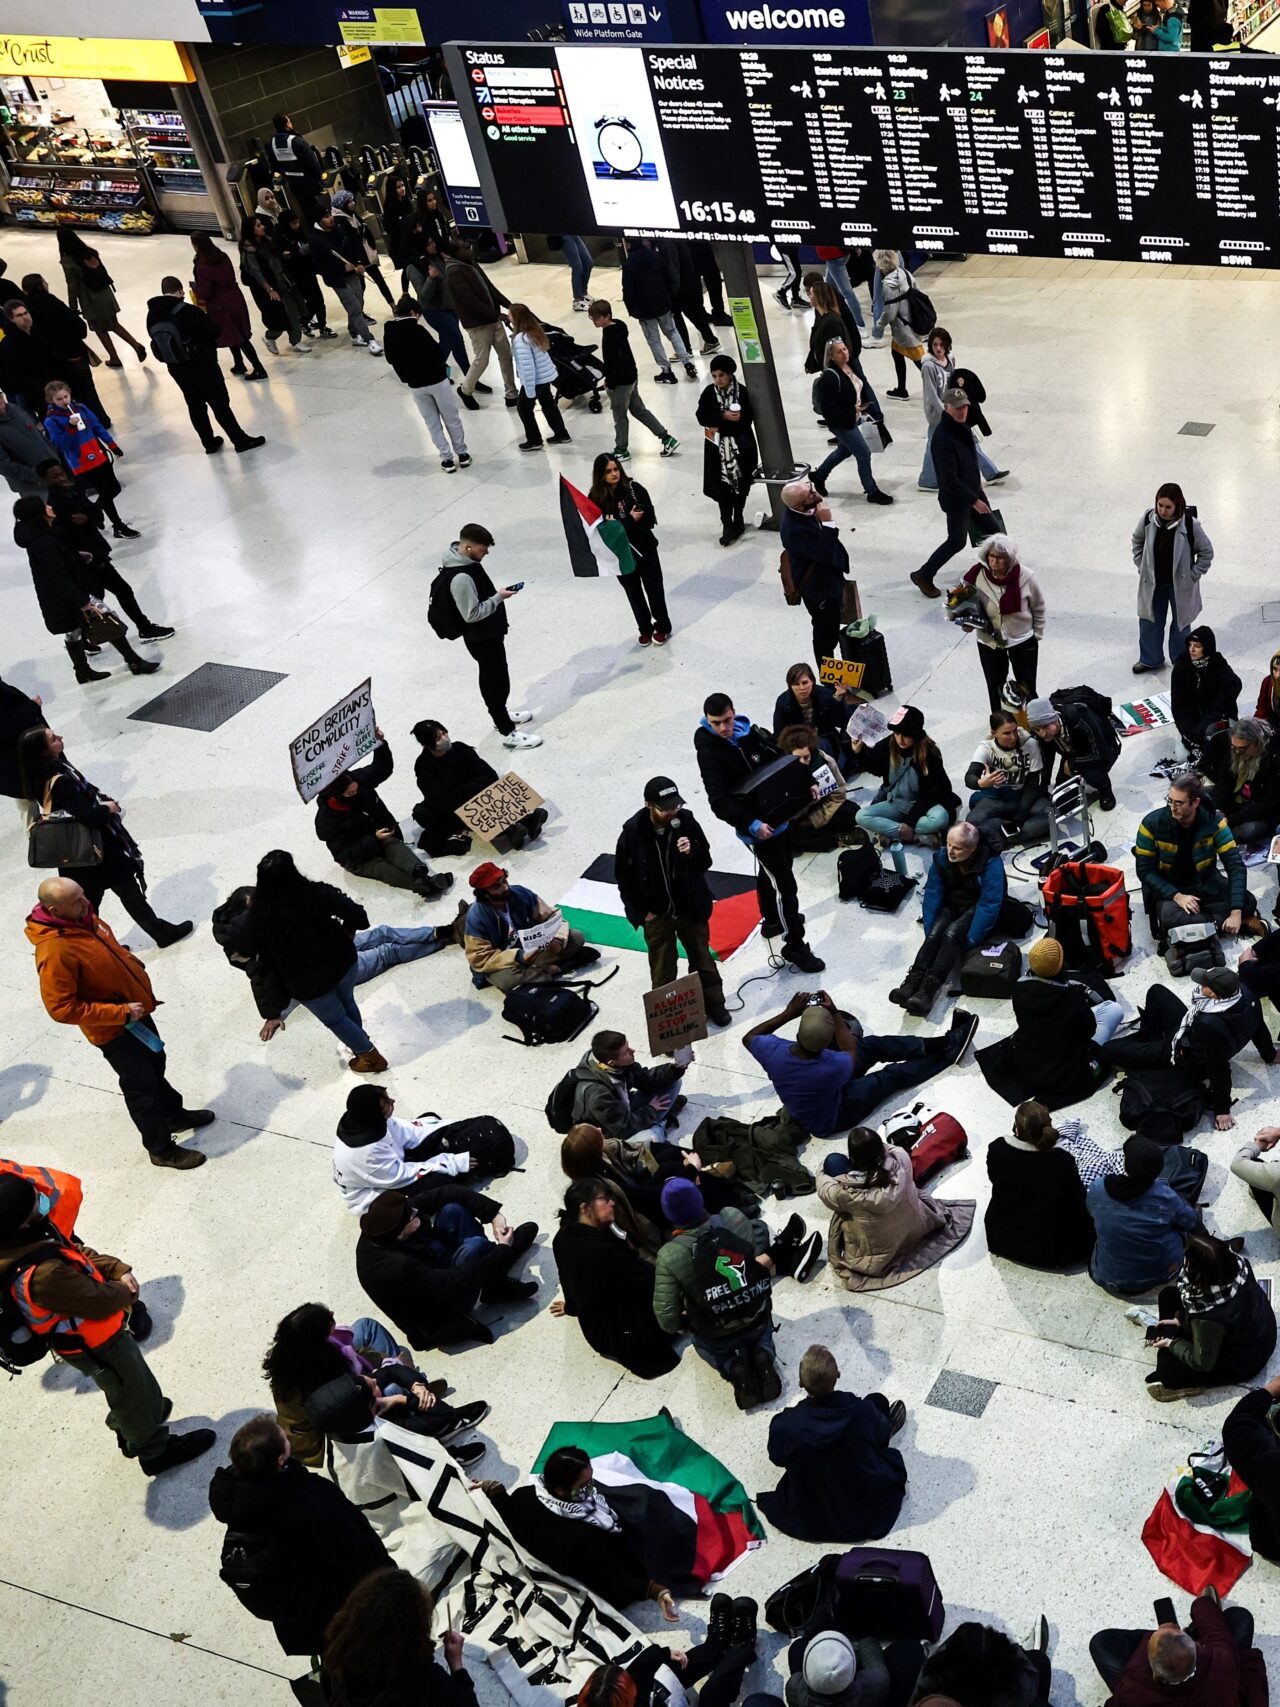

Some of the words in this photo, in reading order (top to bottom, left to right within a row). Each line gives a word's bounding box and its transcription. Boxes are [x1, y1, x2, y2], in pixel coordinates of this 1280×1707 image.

[726, 4, 846, 30] welcome
[574, 28, 592, 38] Wide
[594, 29, 624, 38] Platform
[626, 30, 642, 38] Gate
[10, 40, 54, 66] Crust
[466, 51, 504, 64] Status
[649, 55, 697, 73] Special
[889, 67, 928, 80] Reading
[1046, 70, 1085, 83] Dorking
[1126, 72, 1154, 82] Alton
[1209, 74, 1266, 88] Strawberry
[654, 76, 704, 90] Notices
[893, 90, 906, 99] 23
[970, 92, 982, 101] 24
[1129, 95, 1142, 106] 10
[1211, 97, 1218, 108] 5
[680, 201, 736, 223] 16:15
[739, 209, 756, 223] 48
[294, 730, 320, 755] END
[324, 691, 369, 733] BRITAIN'S
[304, 714, 361, 762] COMPLICITY
[356, 738, 377, 757] DOWN
[331, 742, 350, 774] STRIKE
[307, 773, 322, 790] NOW
[464, 790, 492, 818] STOP
[492, 776, 520, 795] THE
[471, 784, 528, 827] GENOCIDE
[480, 793, 532, 834] CEASEFIRE
[655, 988, 696, 1010] ALWAYS
[658, 1014, 687, 1032] STOP
[660, 1021, 699, 1040] KILLING
[704, 1283, 731, 1301] FREE
[712, 1278, 770, 1314] PALESTINE
